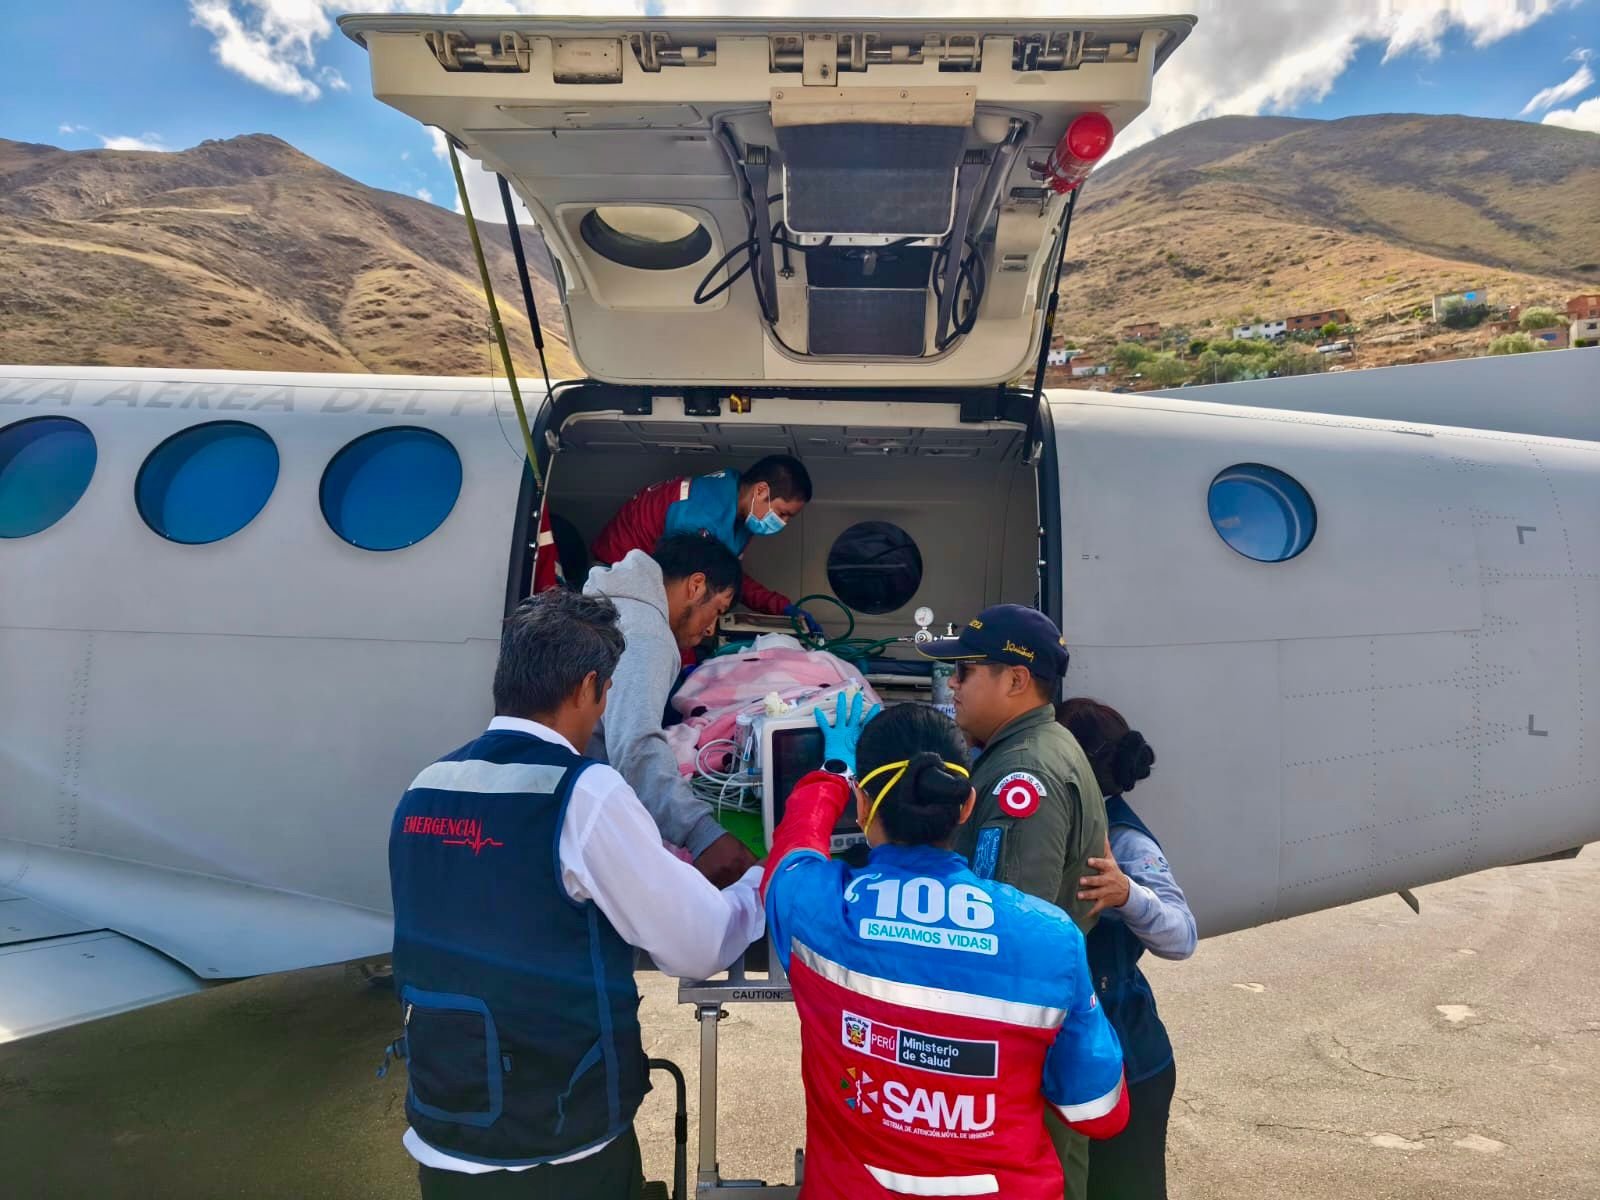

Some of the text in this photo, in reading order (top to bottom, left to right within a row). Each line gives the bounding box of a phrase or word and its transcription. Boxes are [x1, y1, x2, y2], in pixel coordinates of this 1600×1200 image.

[0, 379, 78, 406] ZA
[320, 389, 427, 415] DEL
[403, 816, 478, 838] EMERGENCIA
[866, 877, 995, 930] 106
[732, 990, 784, 1000] CAUTION:
[871, 1033, 896, 1051] PERÚ
[903, 1036, 959, 1057] Ministerio
[902, 1050, 951, 1068] de Salud
[882, 1080, 996, 1131] SAMU
